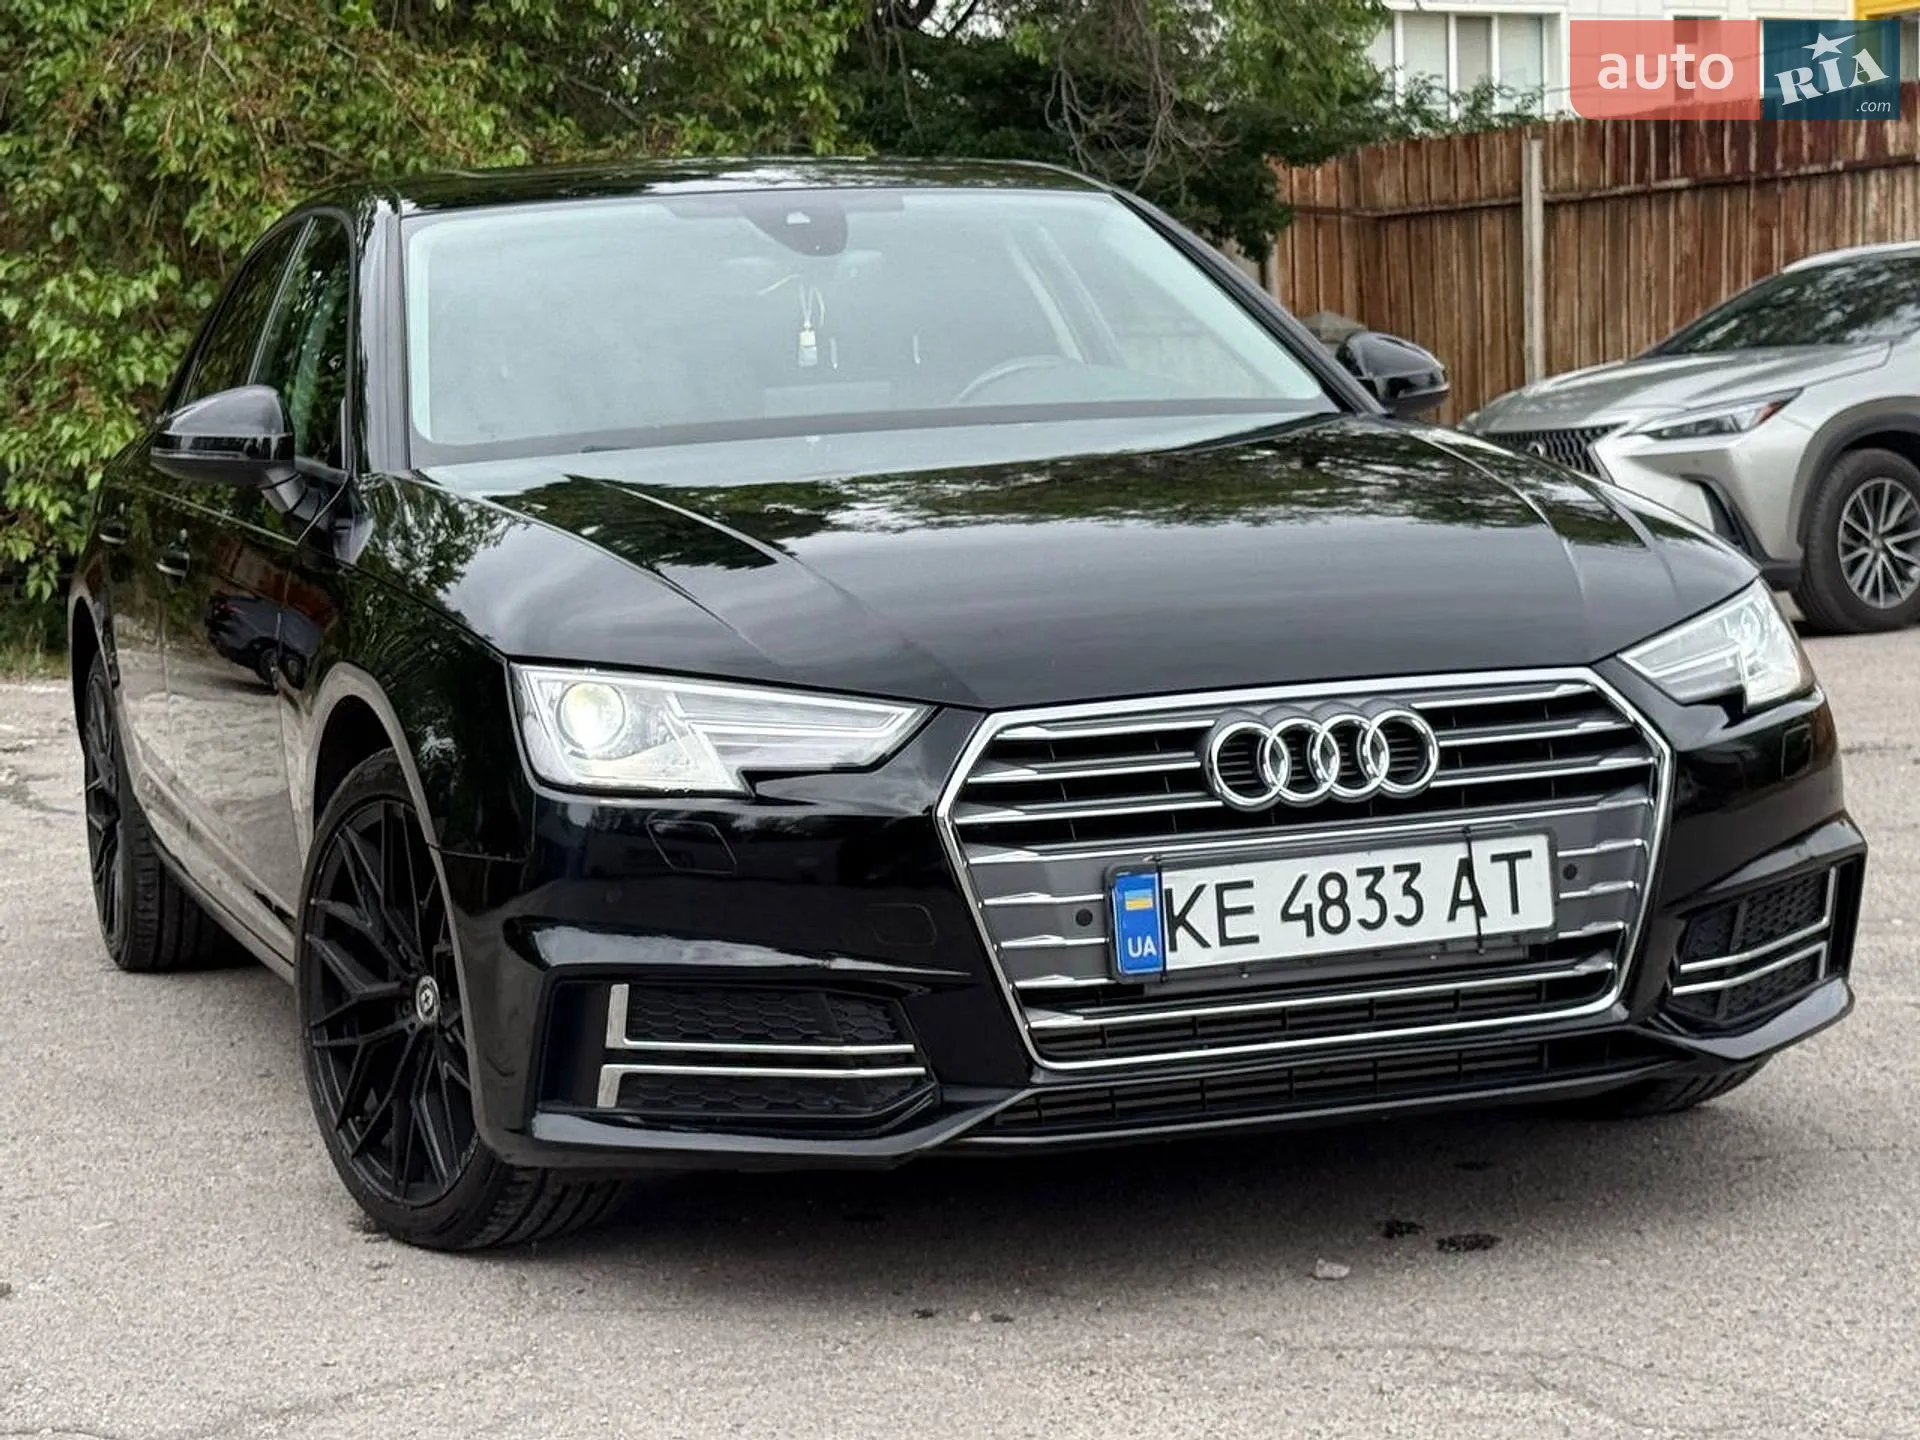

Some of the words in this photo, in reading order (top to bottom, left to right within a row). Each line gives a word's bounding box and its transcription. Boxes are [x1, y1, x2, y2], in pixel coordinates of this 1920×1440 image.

[1164, 879, 1260, 952] KE
[1280, 862, 1424, 937] 4833
[1447, 849, 1533, 922] AT
[1127, 936, 1157, 959] UA
